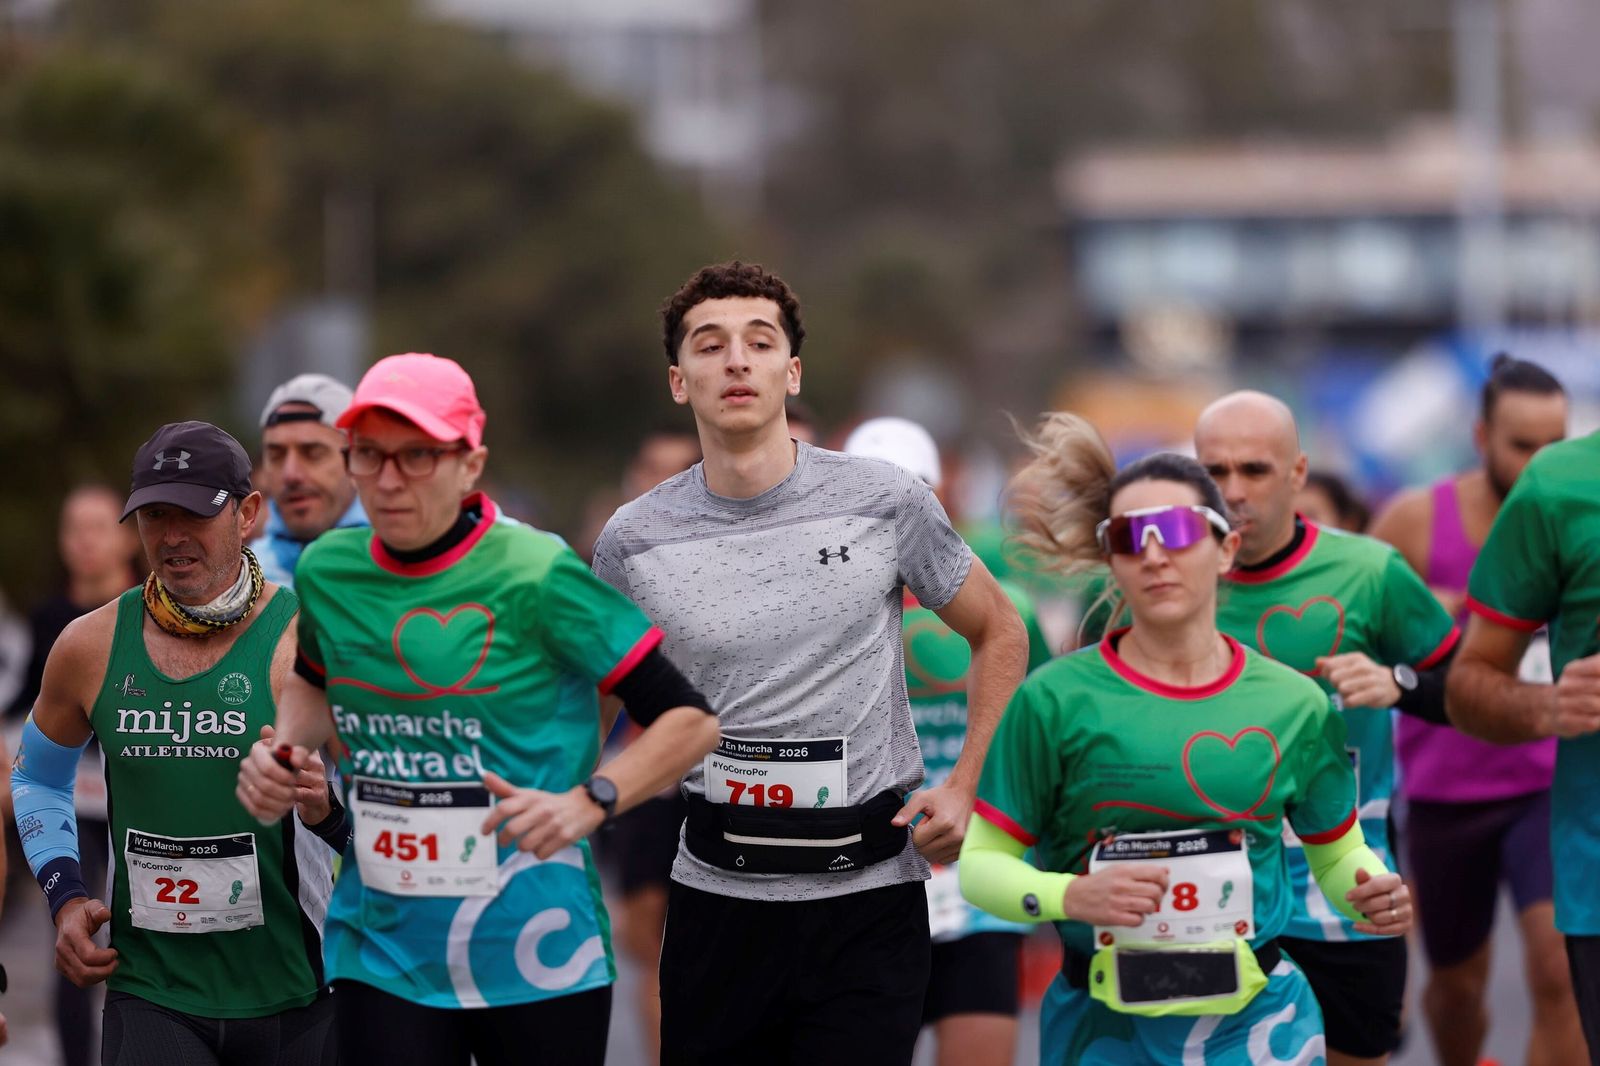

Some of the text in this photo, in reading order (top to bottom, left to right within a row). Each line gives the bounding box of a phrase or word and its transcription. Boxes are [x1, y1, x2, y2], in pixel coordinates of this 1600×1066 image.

[115, 701, 247, 744] mijas
[332, 704, 483, 740] En marcha
[120, 745, 240, 759] ATLETISMO
[725, 741, 736, 750] En
[738, 743, 773, 753] Marcha
[779, 747, 809, 758] 2026
[353, 744, 486, 778] ontra el
[712, 761, 769, 777] #YoCorroPor
[419, 790, 453, 805] 2026
[725, 779, 794, 809] 719
[143, 838, 152, 848] En
[153, 840, 184, 852] Marcha
[190, 844, 218, 855] 2026
[373, 830, 438, 862] 451
[1176, 837, 1209, 853] 2026
[132, 859, 182, 872] #YoCorroPor
[155, 877, 200, 905] 22
